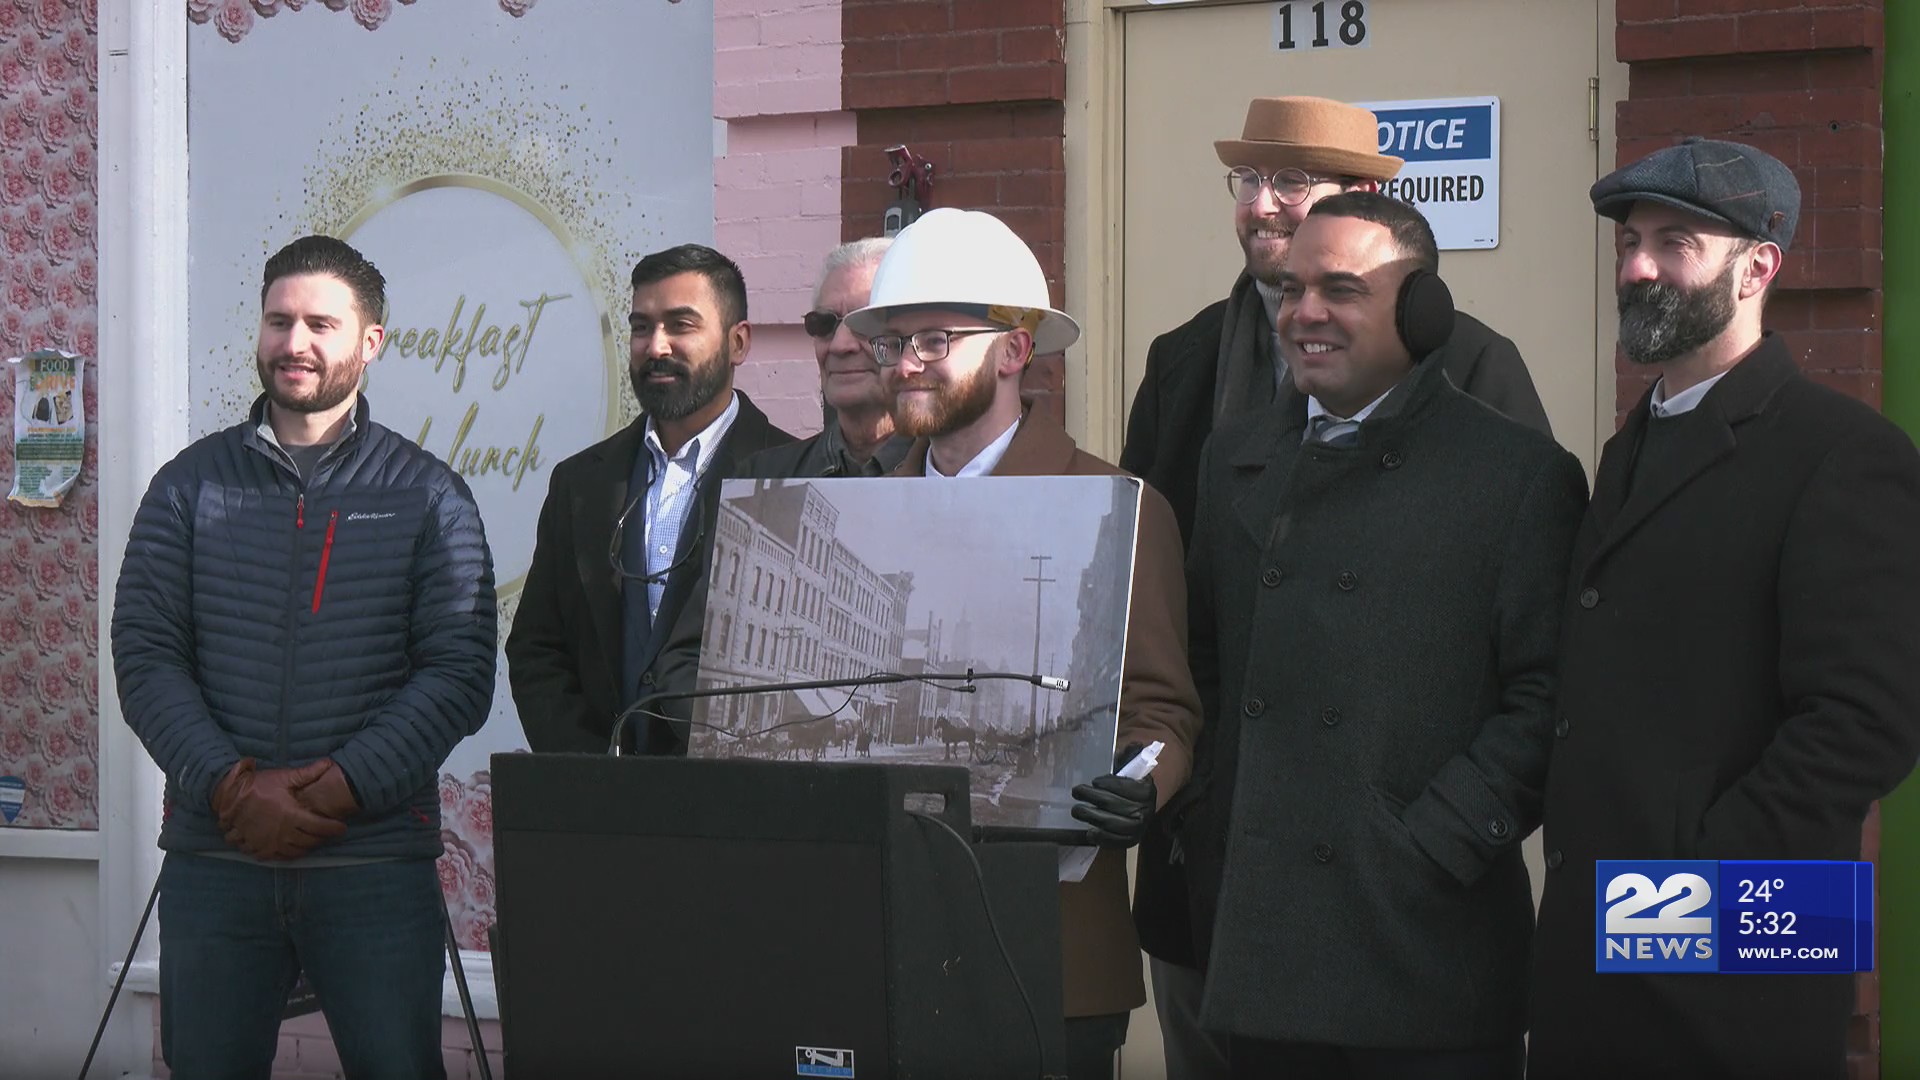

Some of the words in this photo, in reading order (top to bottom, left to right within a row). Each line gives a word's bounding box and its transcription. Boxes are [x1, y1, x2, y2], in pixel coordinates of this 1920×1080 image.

[1279, 1, 1366, 49] 118
[1378, 118, 1466, 152] OTICE
[377, 294, 572, 393] reakfast
[40, 359, 70, 372] FOOD
